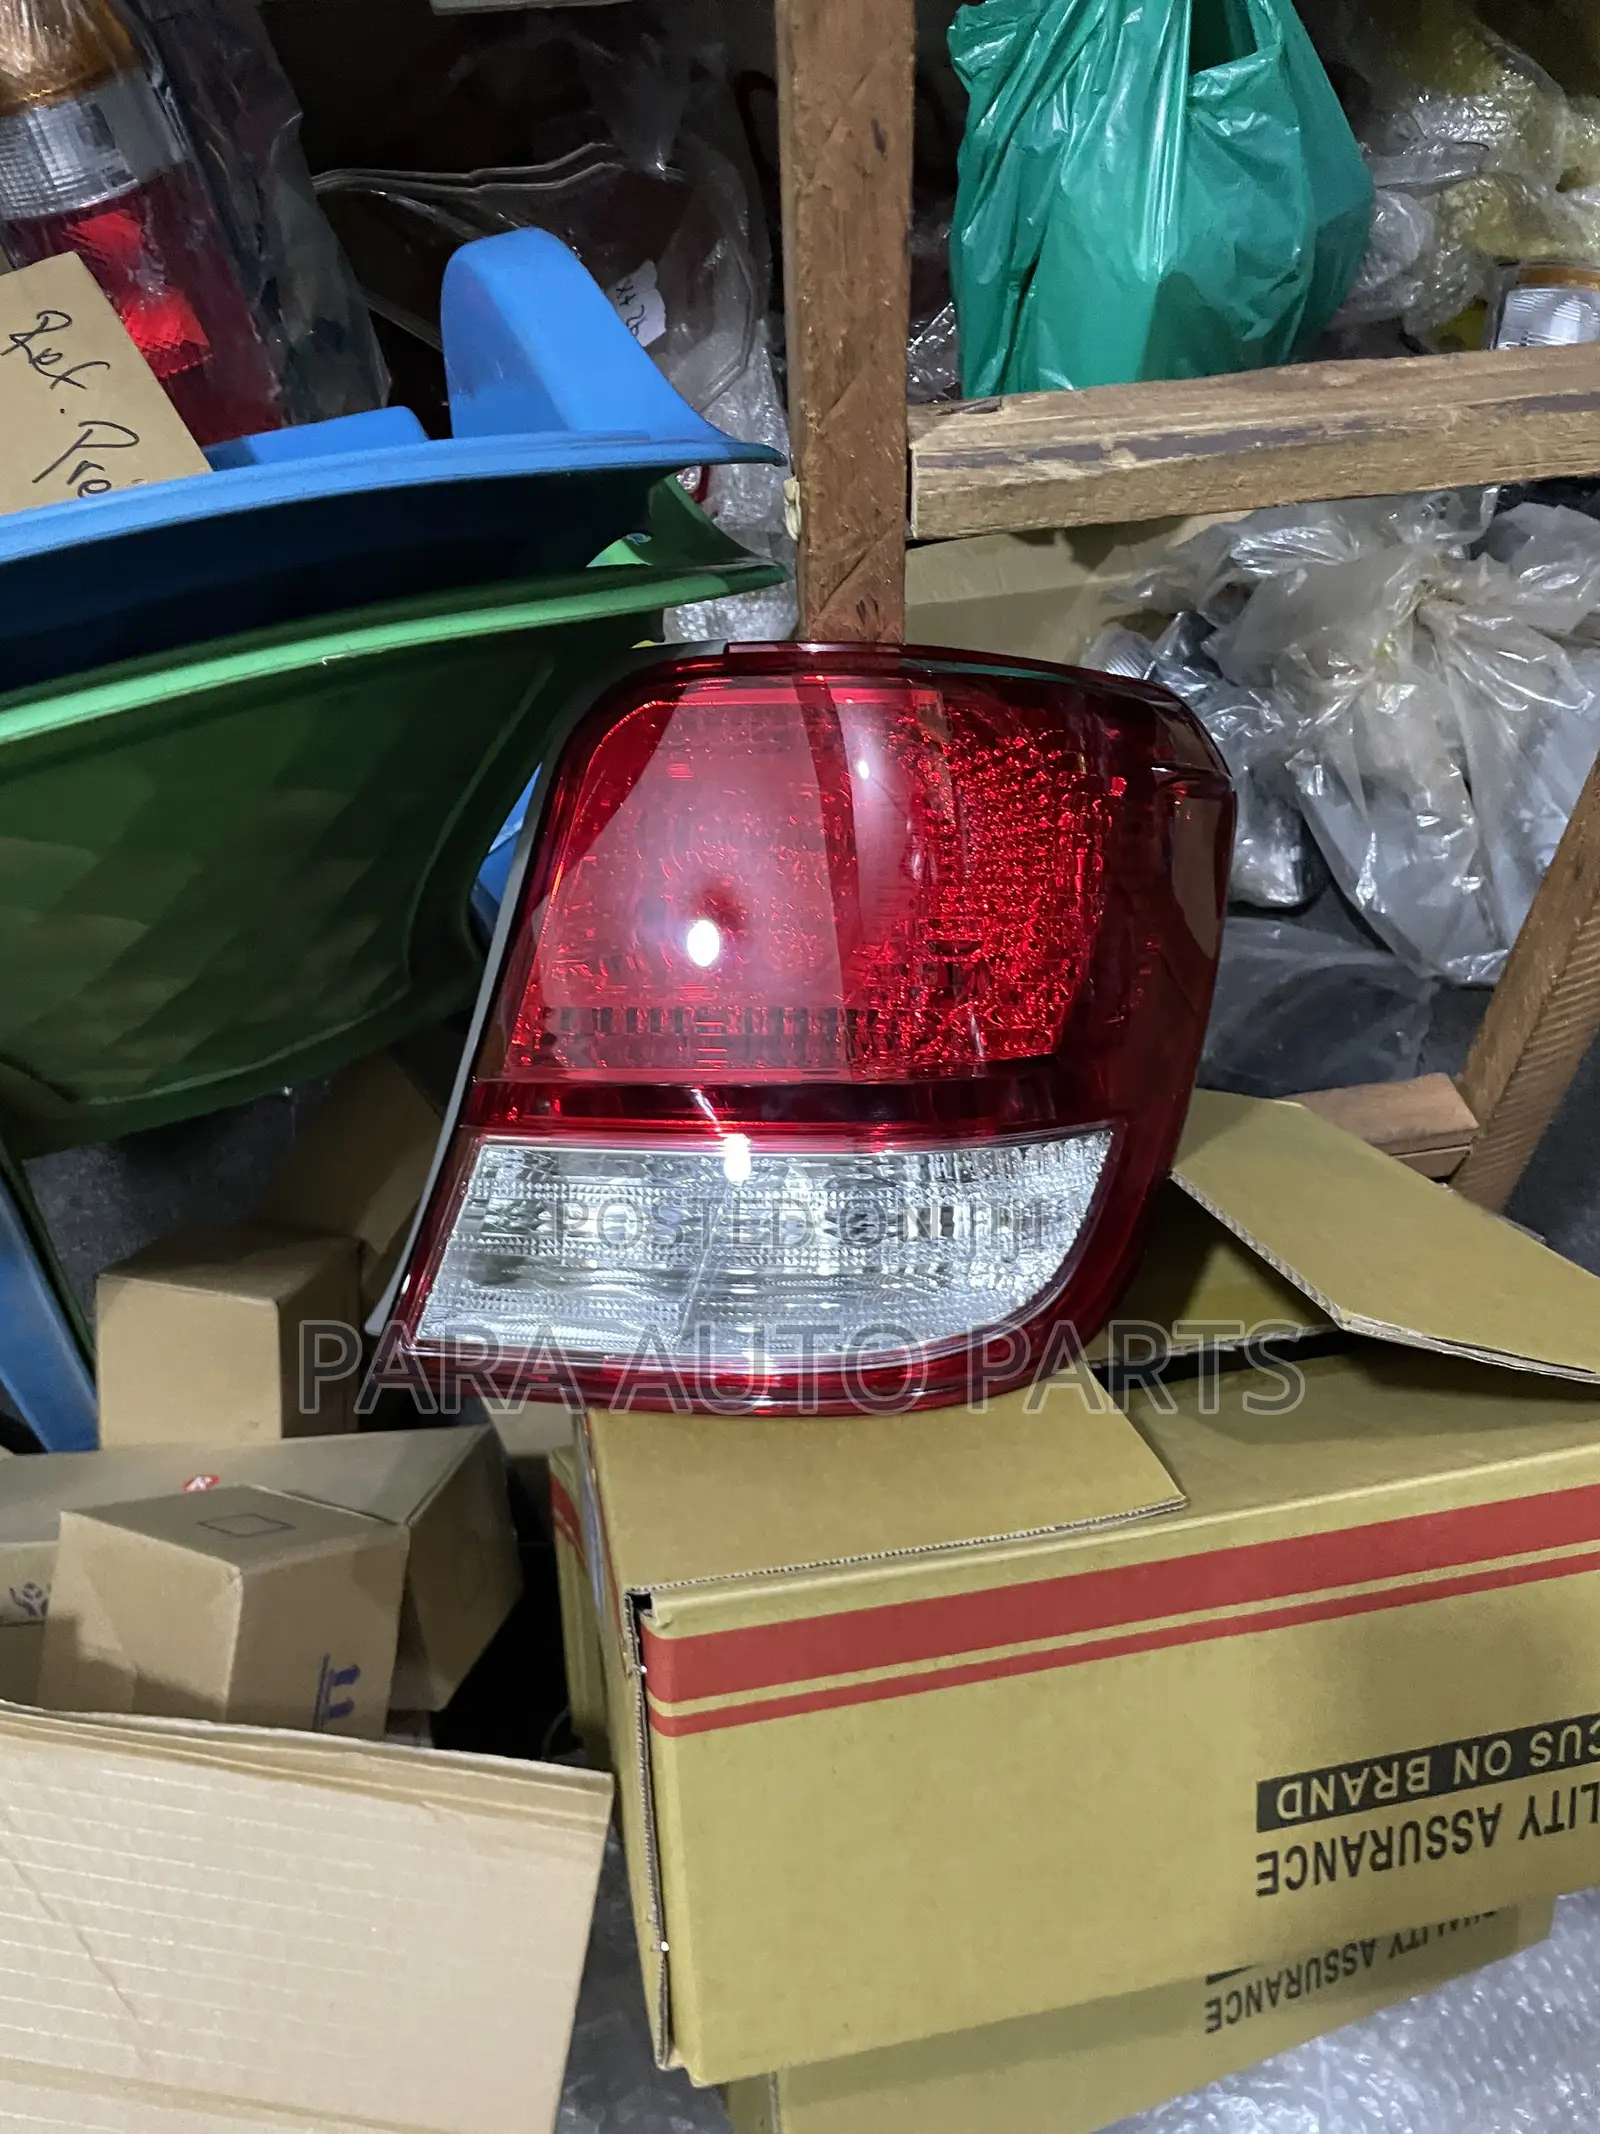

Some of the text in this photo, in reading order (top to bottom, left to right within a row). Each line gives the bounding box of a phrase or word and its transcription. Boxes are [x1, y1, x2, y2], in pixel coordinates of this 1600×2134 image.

[1276, 1755, 1432, 1821] BRAND
[1454, 1740, 1513, 1786] ON
[1255, 1803, 1502, 1896] ASSURANCE
[1205, 1936, 1377, 2033] ASSURANCE
